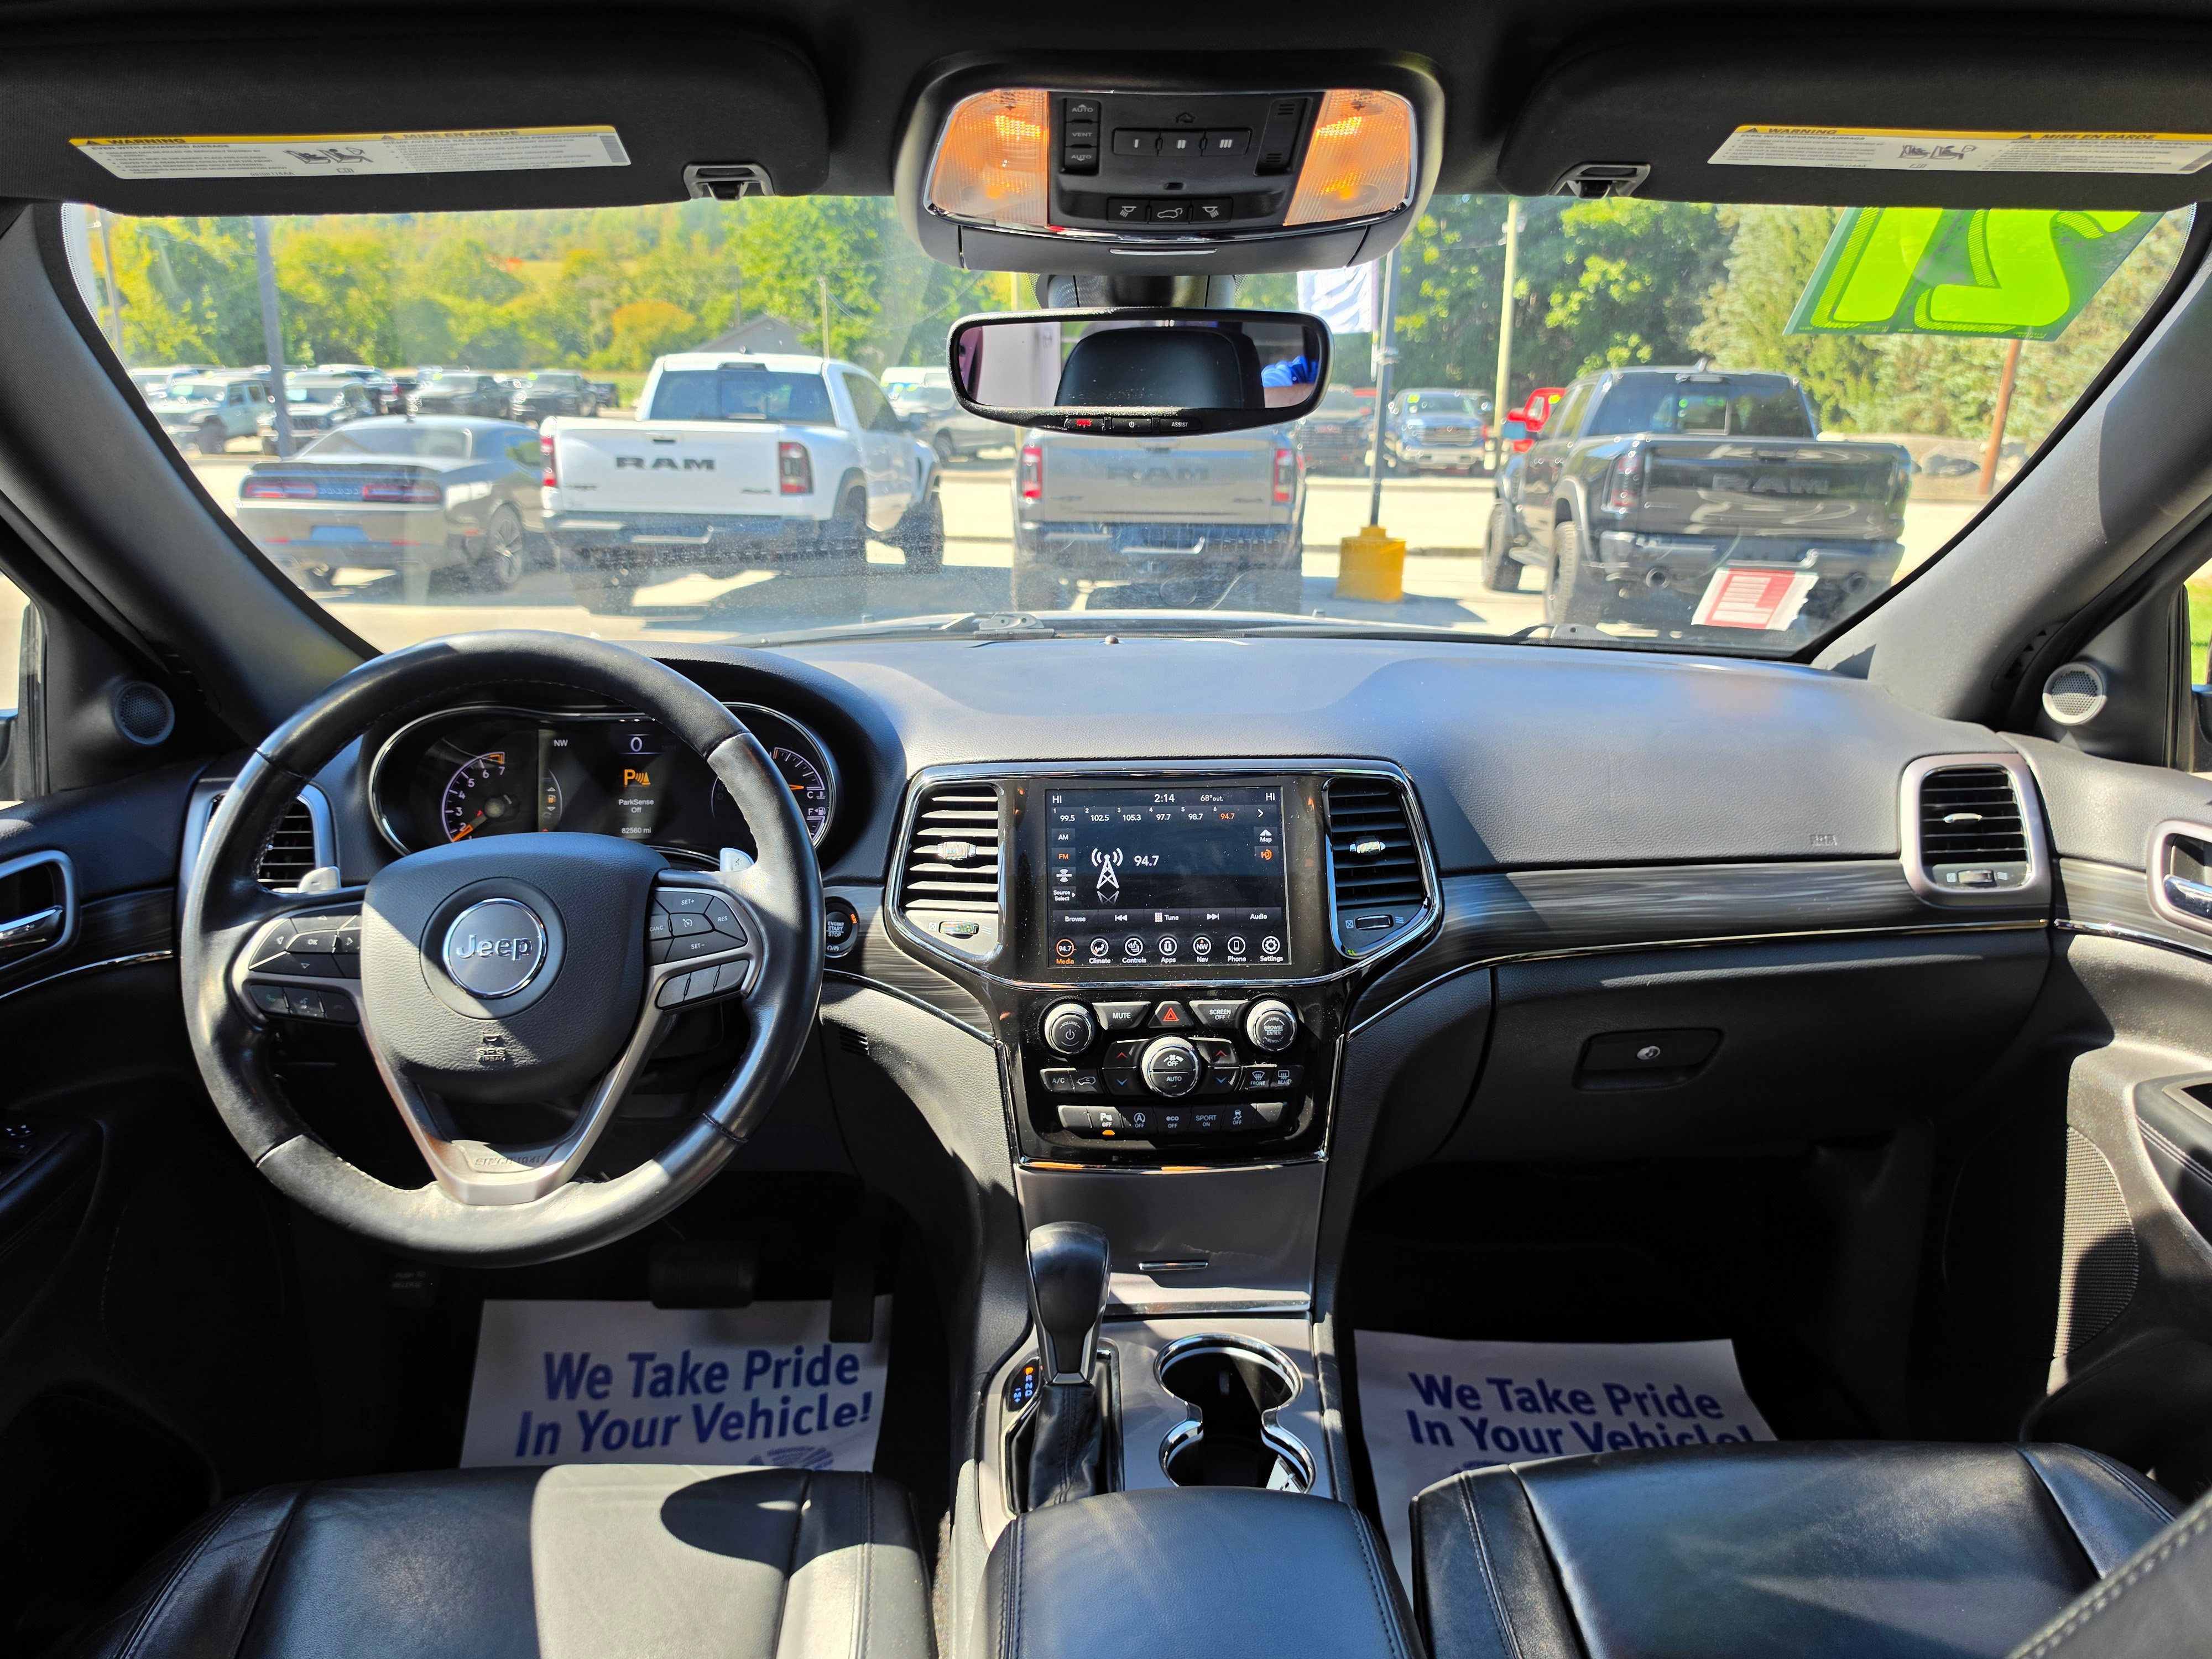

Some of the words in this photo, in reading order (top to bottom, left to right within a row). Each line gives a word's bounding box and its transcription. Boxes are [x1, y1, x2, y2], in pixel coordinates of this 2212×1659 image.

[615, 457, 716, 471] RAM
[1712, 474, 1829, 495] RAM
[630, 736, 643, 753] 0
[482, 769, 489, 779] 6
[499, 766, 505, 775] 7
[468, 778, 475, 787] 5
[458, 791, 466, 800] 4
[807, 791, 813, 799] C
[1052, 795, 1062, 804] HI
[1154, 794, 1175, 803] 2:14
[1265, 792, 1276, 801] HI
[456, 807, 463, 816] 3
[460, 822, 467, 832] 2
[1134, 854, 1160, 867] 94.7
[717, 915, 728, 923] RES
[649, 924, 664, 932] CANC
[456, 934, 534, 962] Jeep
[476, 1047, 506, 1055] SRS
[543, 1350, 613, 1402] We
[627, 1348, 730, 1399] Take
[743, 1343, 859, 1391] Pride
[1025, 1366, 1034, 1375] P
[1407, 1371, 1482, 1412] We
[1485, 1376, 1597, 1416] Take
[1602, 1381, 1725, 1421] Pride
[515, 1410, 561, 1458] In
[577, 1408, 682, 1453] Your
[691, 1391, 873, 1443] Vehicle!
[1405, 1408, 1455, 1448] In
[1458, 1416, 1565, 1455] Your
